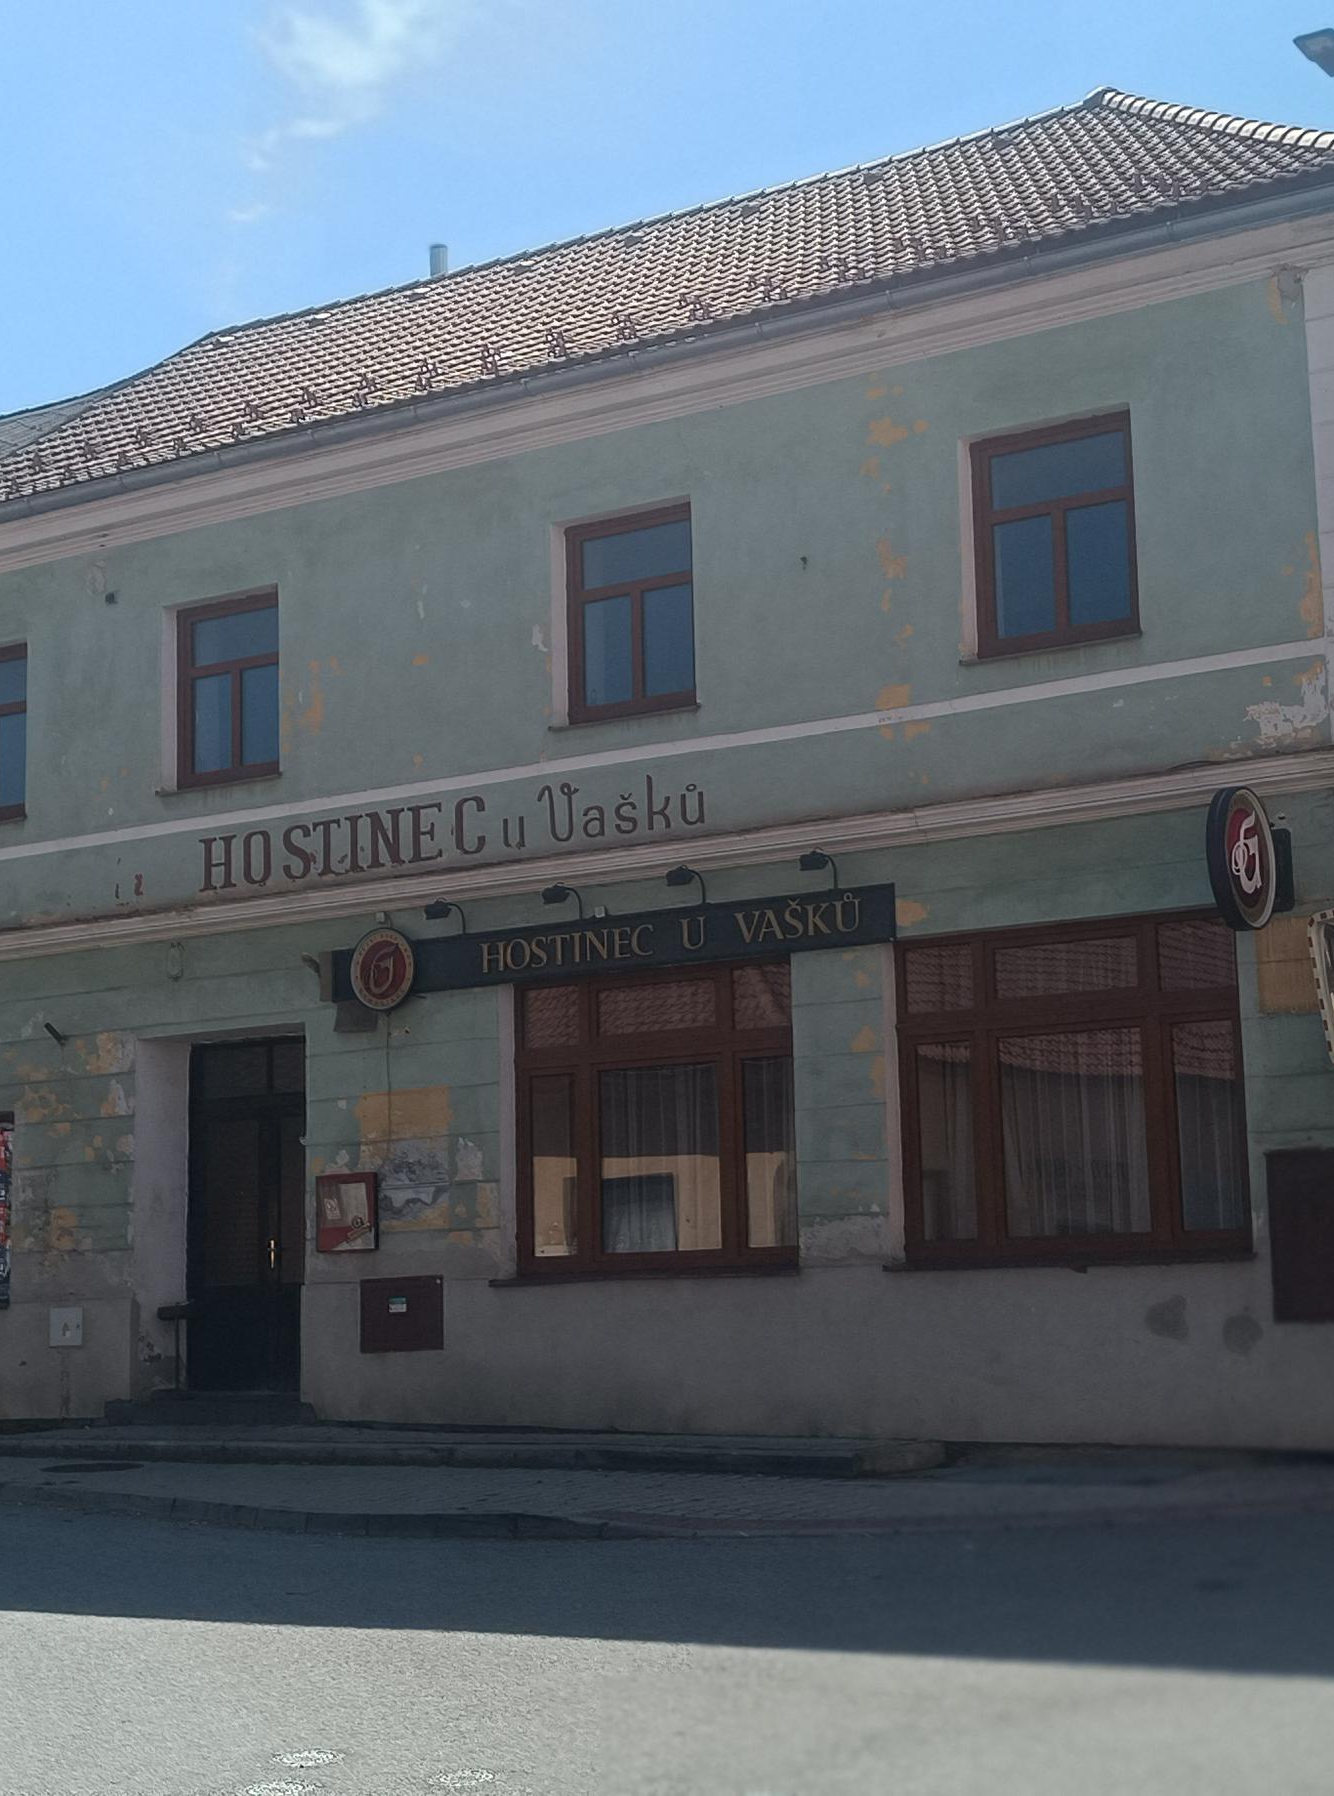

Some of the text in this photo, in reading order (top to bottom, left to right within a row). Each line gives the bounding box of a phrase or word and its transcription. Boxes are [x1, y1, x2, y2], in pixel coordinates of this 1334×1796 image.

[199, 796, 487, 892] HOSTINEC
[538, 774, 707, 843] Vašků
[480, 892, 861, 974] HOSTINEC U VAŠKŮ
